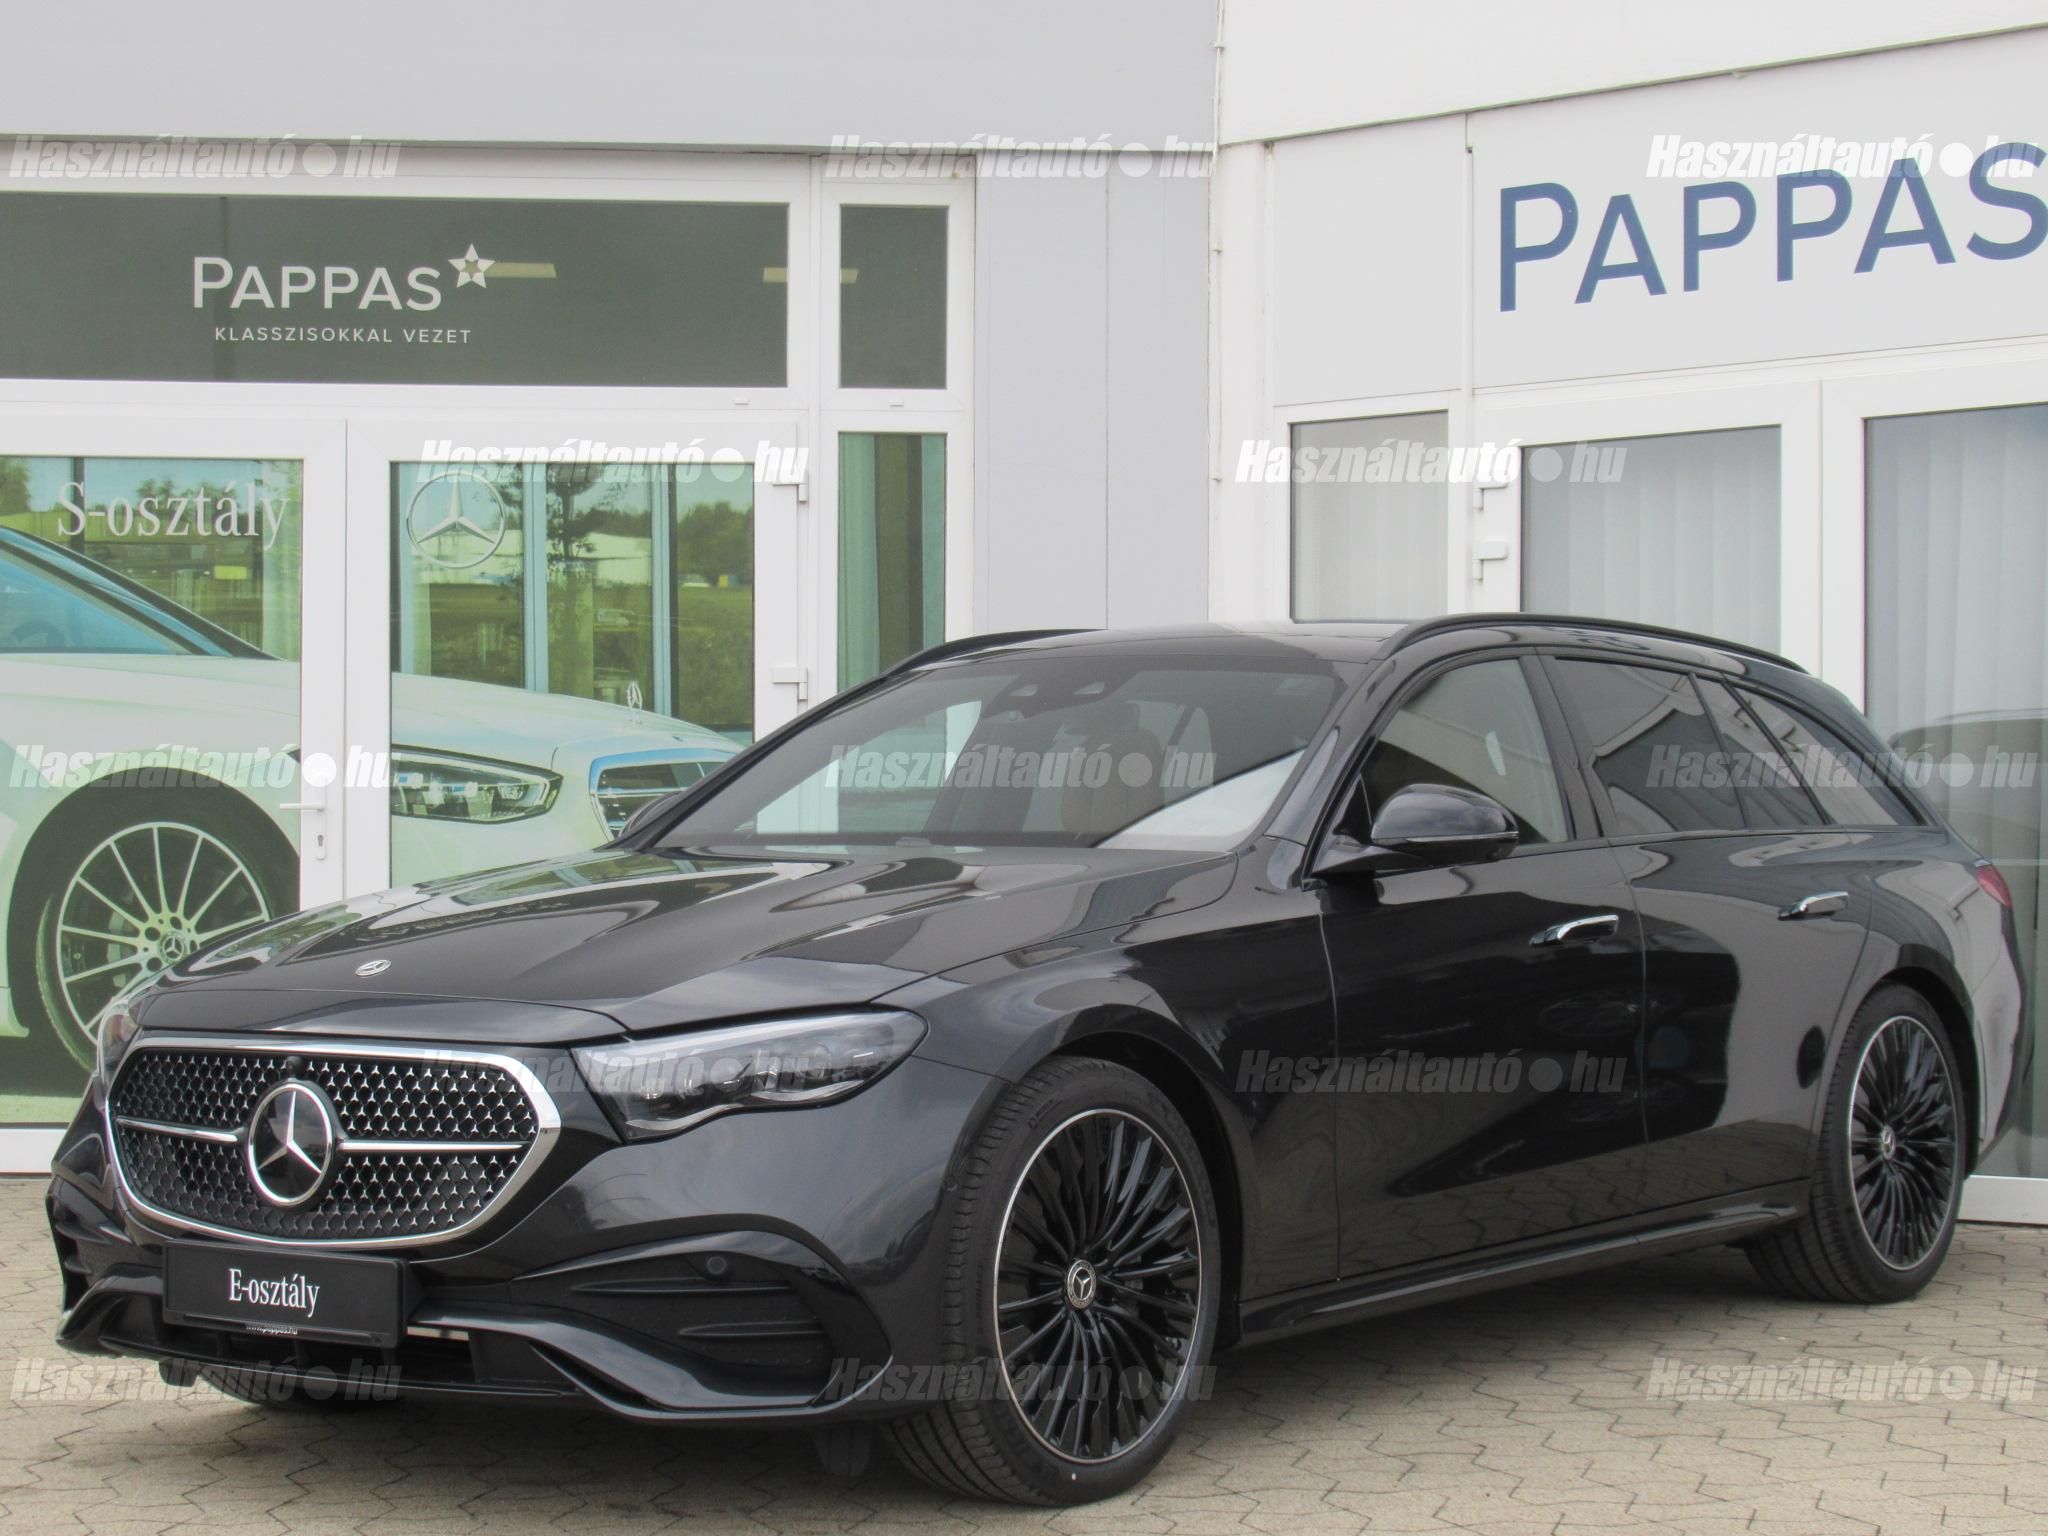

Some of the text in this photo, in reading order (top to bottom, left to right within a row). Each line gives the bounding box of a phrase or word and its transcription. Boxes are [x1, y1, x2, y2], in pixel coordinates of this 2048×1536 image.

[1500, 142, 2048, 312] PAPPAS
[193, 256, 442, 311] PAPPAS
[215, 326, 471, 344] KLASSZISOKKAL VEZET
[57, 481, 290, 551] S-osztály
[229, 1268, 320, 1318] E-osztály
